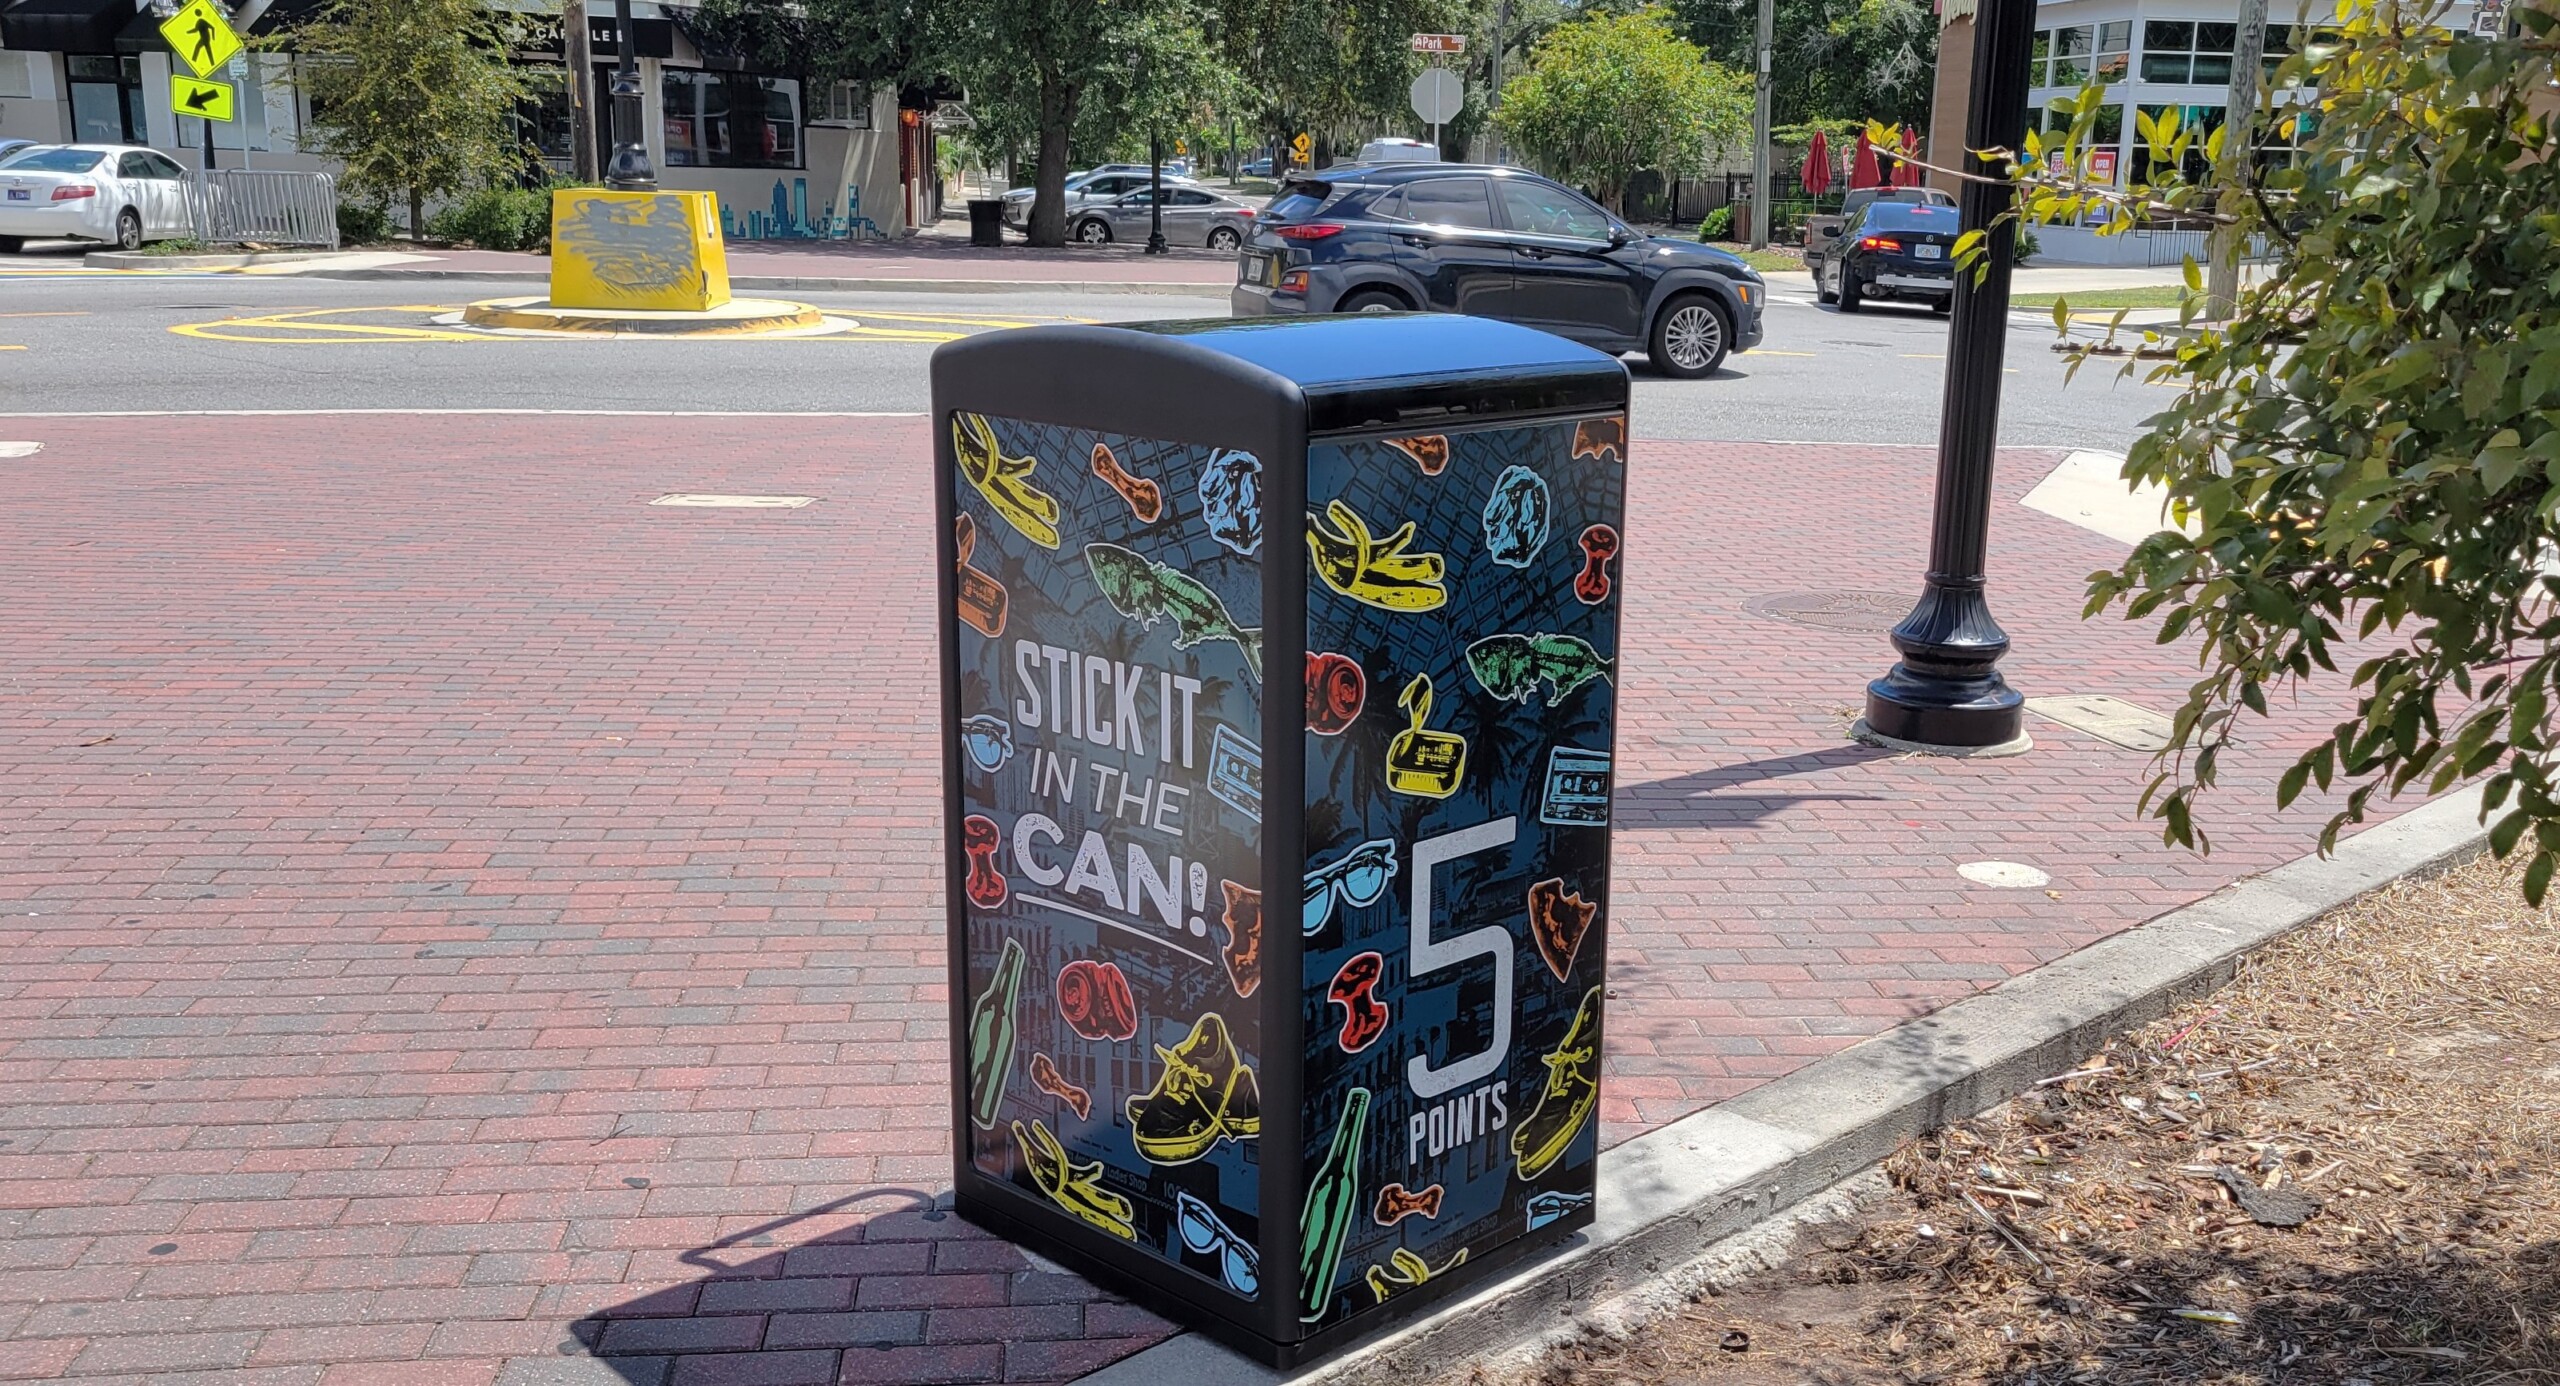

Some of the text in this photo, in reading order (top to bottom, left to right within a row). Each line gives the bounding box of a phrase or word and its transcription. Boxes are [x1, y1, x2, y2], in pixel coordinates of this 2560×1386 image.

[1423, 36, 1443, 49] Park
[2095, 159, 2110, 168] OPEN
[1015, 639, 1145, 756] STICK
[1160, 671, 1202, 769] IT
[1030, 747, 1189, 837] IN THE
[1012, 812, 1208, 938] CAN!
[1408, 815, 1517, 1099] 5
[1409, 1080, 1507, 1165] POINTS
[1129, 1175, 1147, 1193] Shop
